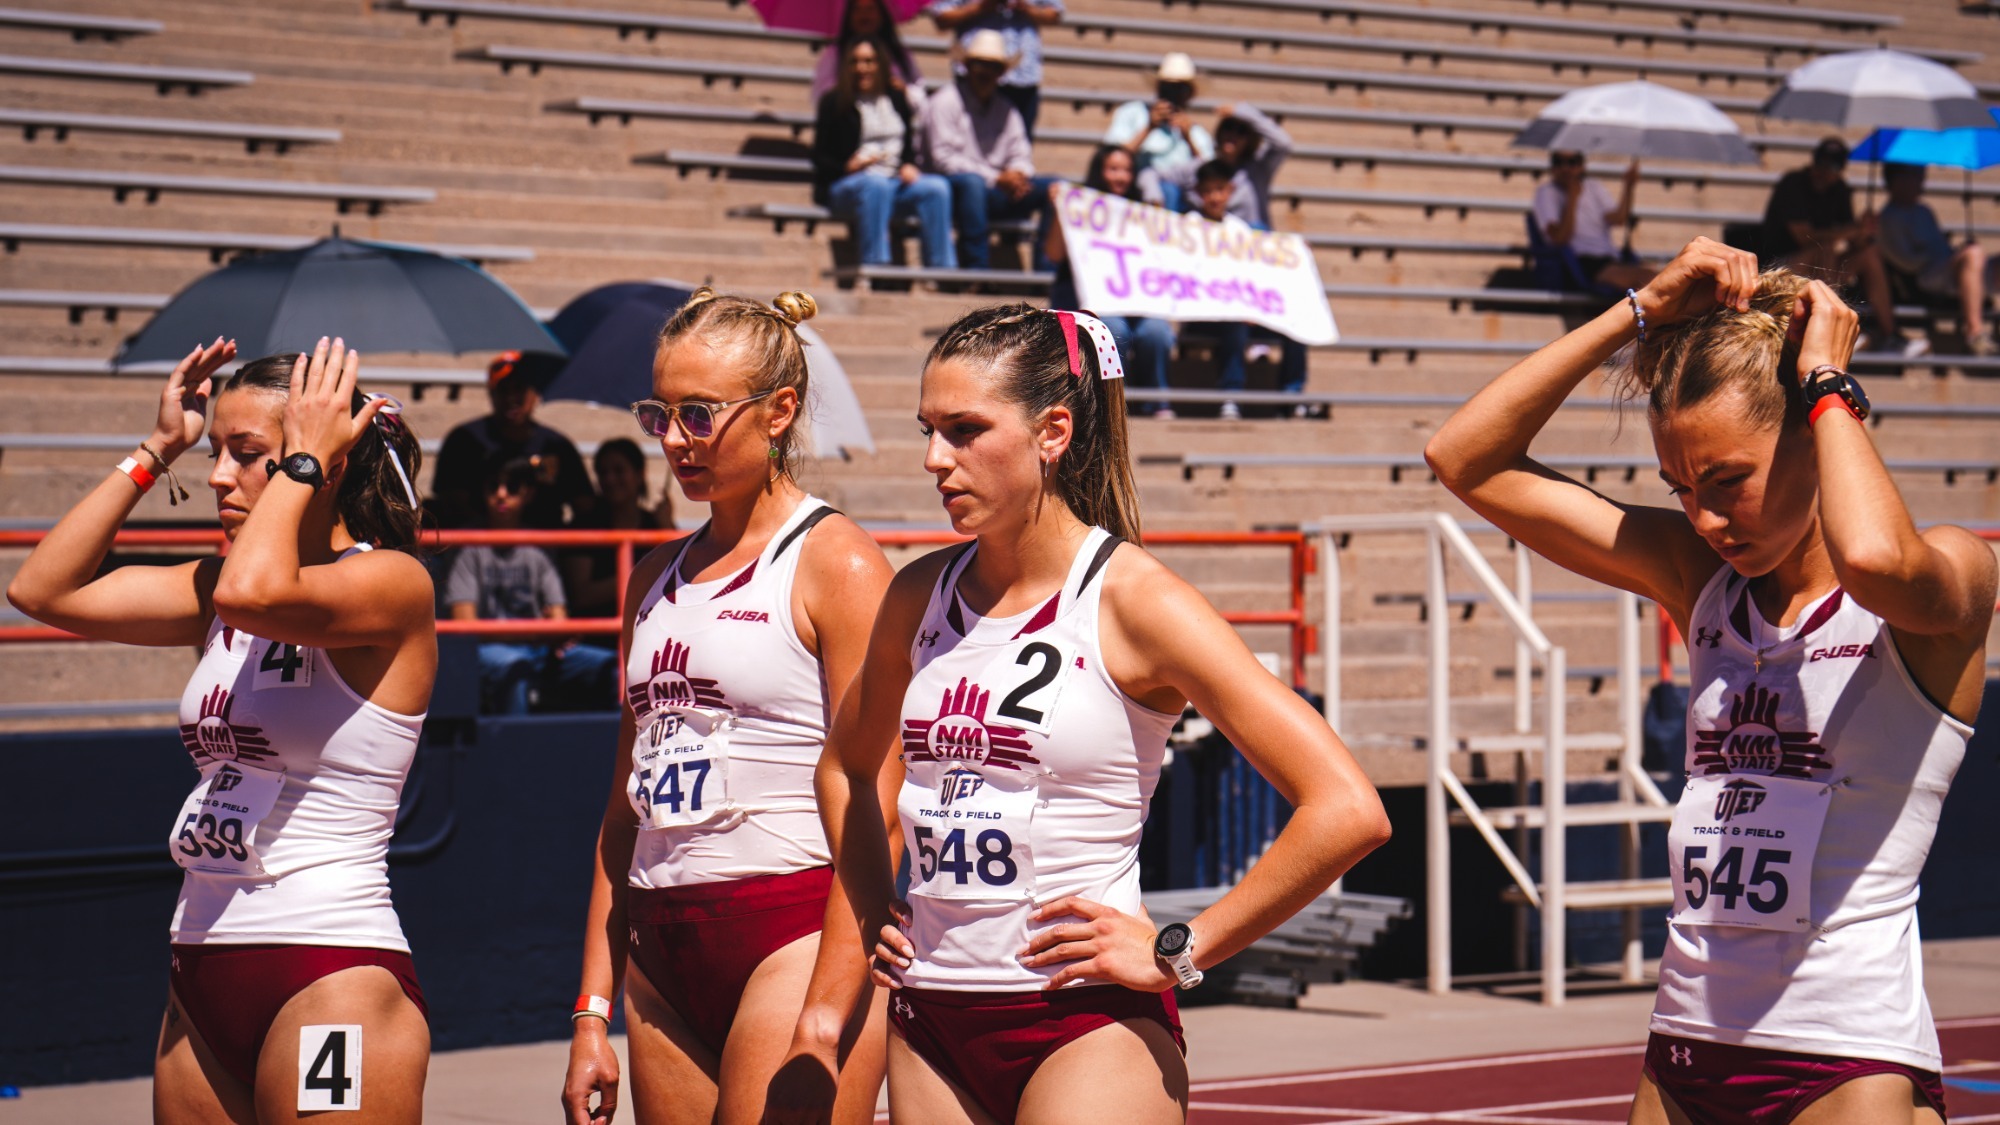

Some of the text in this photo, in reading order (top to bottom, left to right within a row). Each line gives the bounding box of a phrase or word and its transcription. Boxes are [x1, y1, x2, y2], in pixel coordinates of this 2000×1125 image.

[1064, 187, 1300, 270] GO MUSTANGS
[260, 642, 303, 682] 4
[653, 681, 689, 699] NM
[996, 642, 1062, 725] 2
[200, 726, 231, 744] NM
[936, 725, 983, 747] NM
[1728, 734, 1775, 755] NM
[204, 742, 234, 755] STATE
[674, 744, 704, 755] FIELD
[935, 745, 983, 761] STATE
[1729, 755, 1776, 770] STATE
[636, 759, 711, 819] 547
[941, 768, 984, 806] UTEP
[221, 802, 249, 814] FIELD
[1714, 778, 1767, 822] UTEP
[919, 809, 949, 818] TRACK
[966, 811, 1002, 820] FIELD
[178, 813, 248, 862] 539
[1693, 826, 1785, 839] TRACK & FIELD
[914, 826, 1018, 886] 548
[1683, 846, 1791, 914] 545
[305, 1031, 352, 1105] 4
